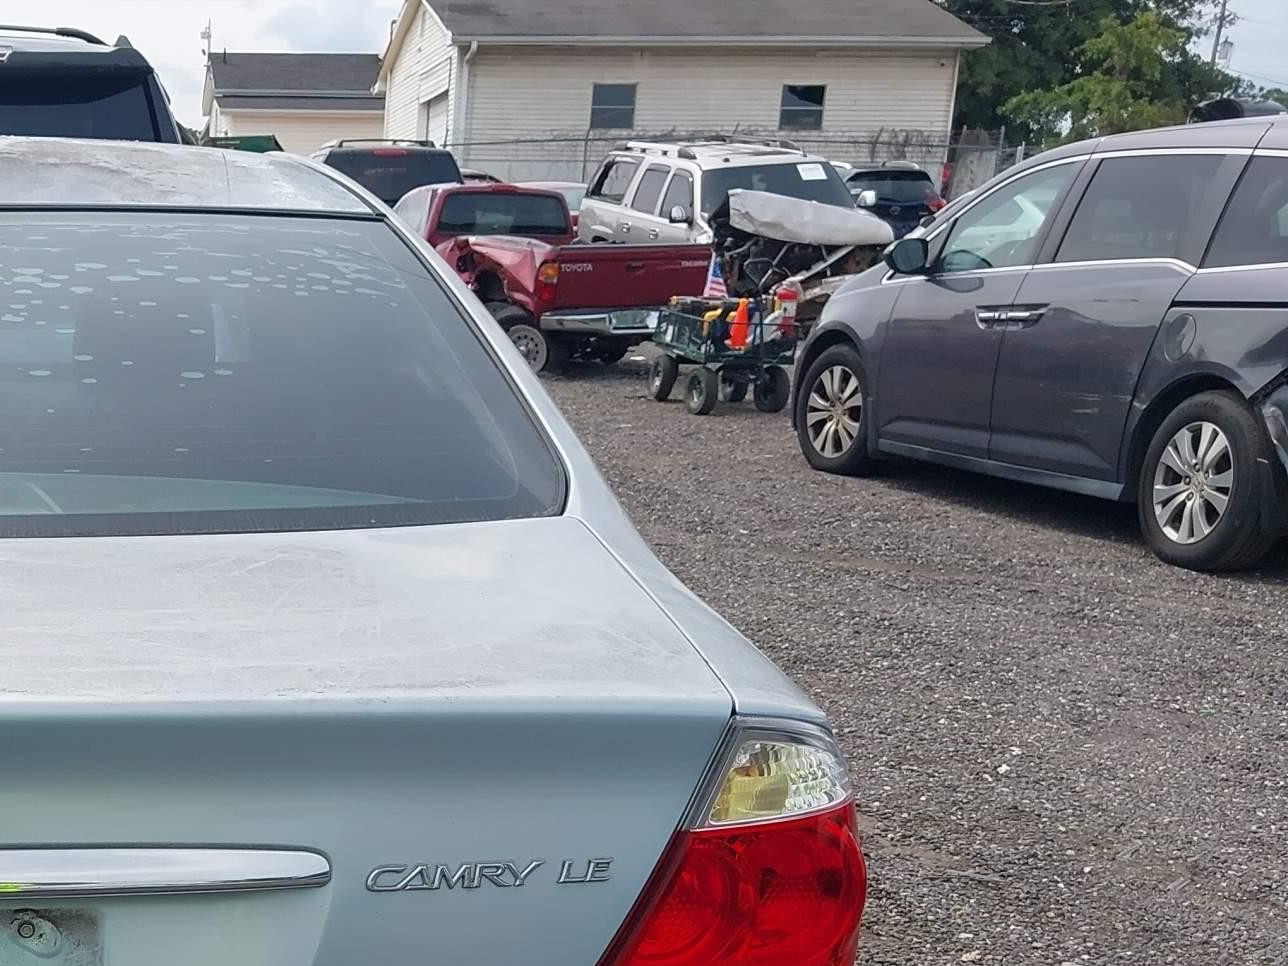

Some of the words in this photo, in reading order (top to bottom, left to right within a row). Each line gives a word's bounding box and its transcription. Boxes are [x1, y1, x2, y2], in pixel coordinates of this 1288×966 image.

[561, 263, 593, 273] TOYOTA
[365, 859, 544, 892] CAMRY
[557, 857, 614, 884] LE
